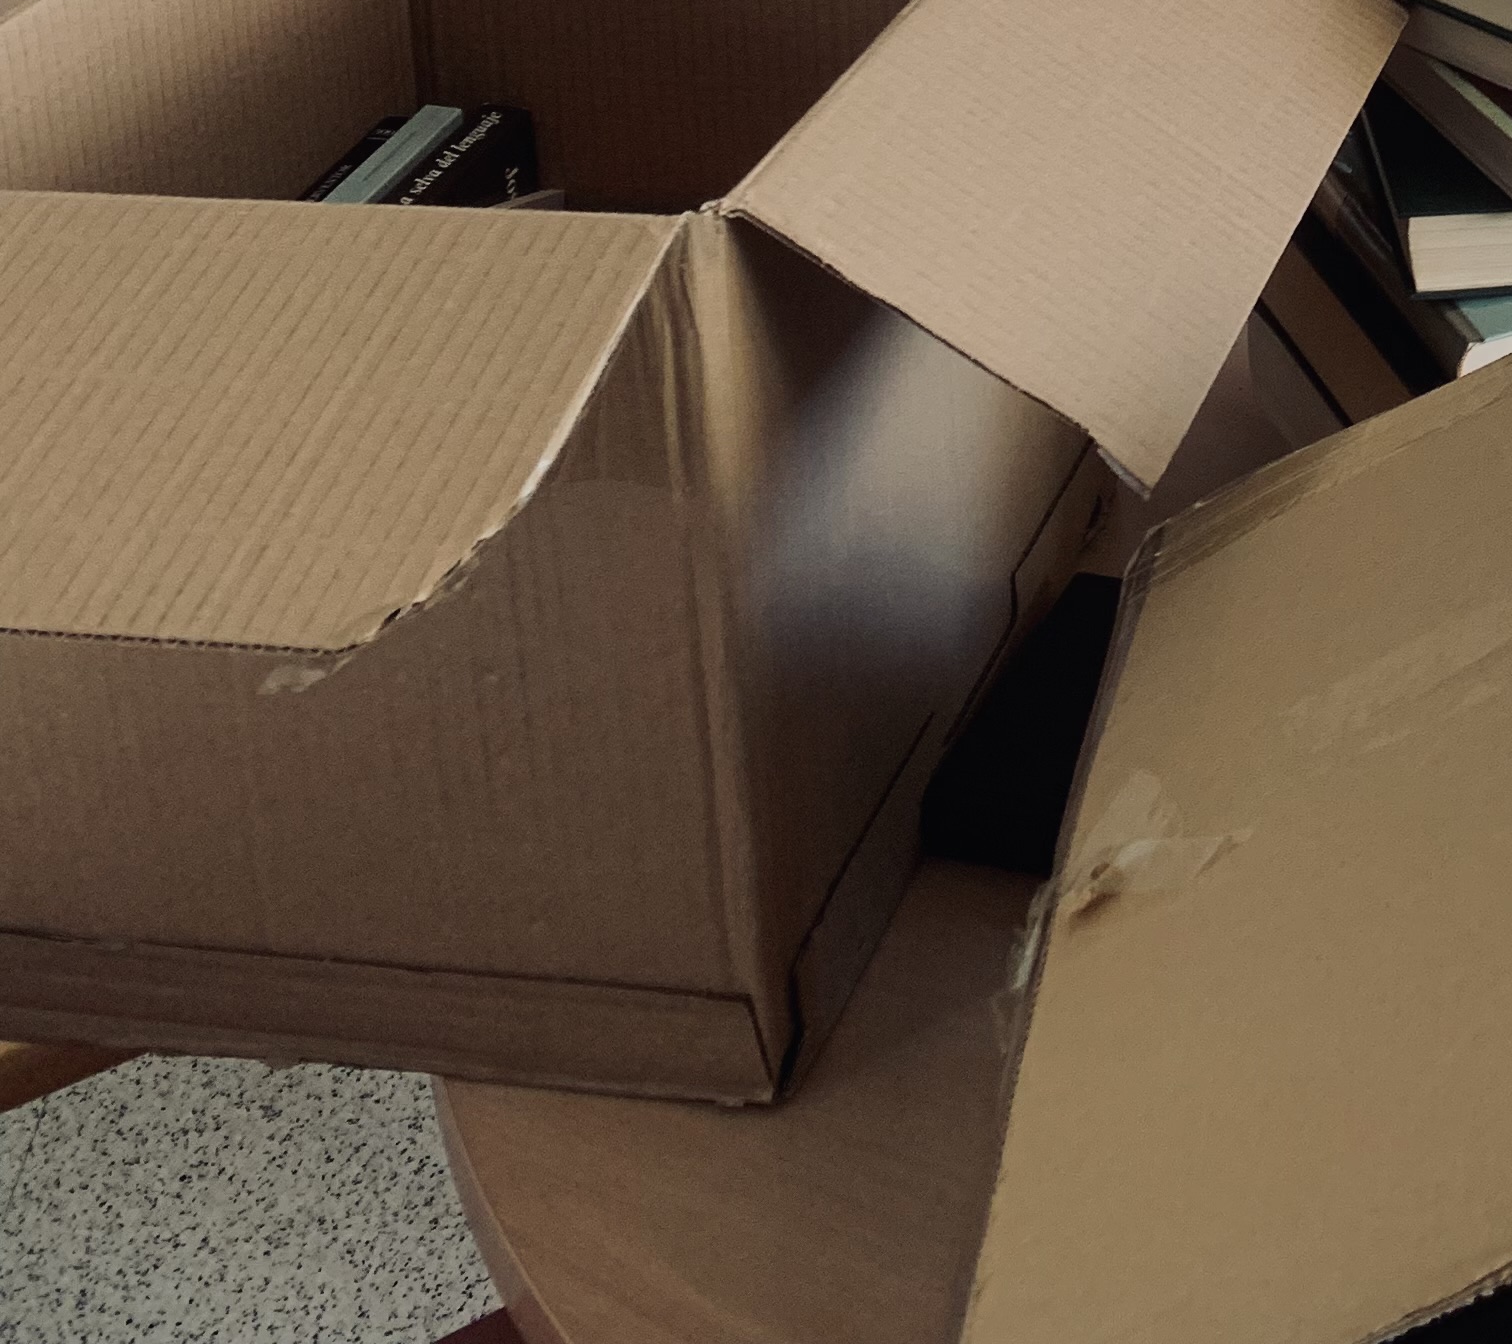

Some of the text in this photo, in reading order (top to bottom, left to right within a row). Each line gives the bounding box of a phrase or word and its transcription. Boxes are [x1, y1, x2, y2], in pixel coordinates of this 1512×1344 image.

[409, 110, 502, 196] selva del lenguaje
